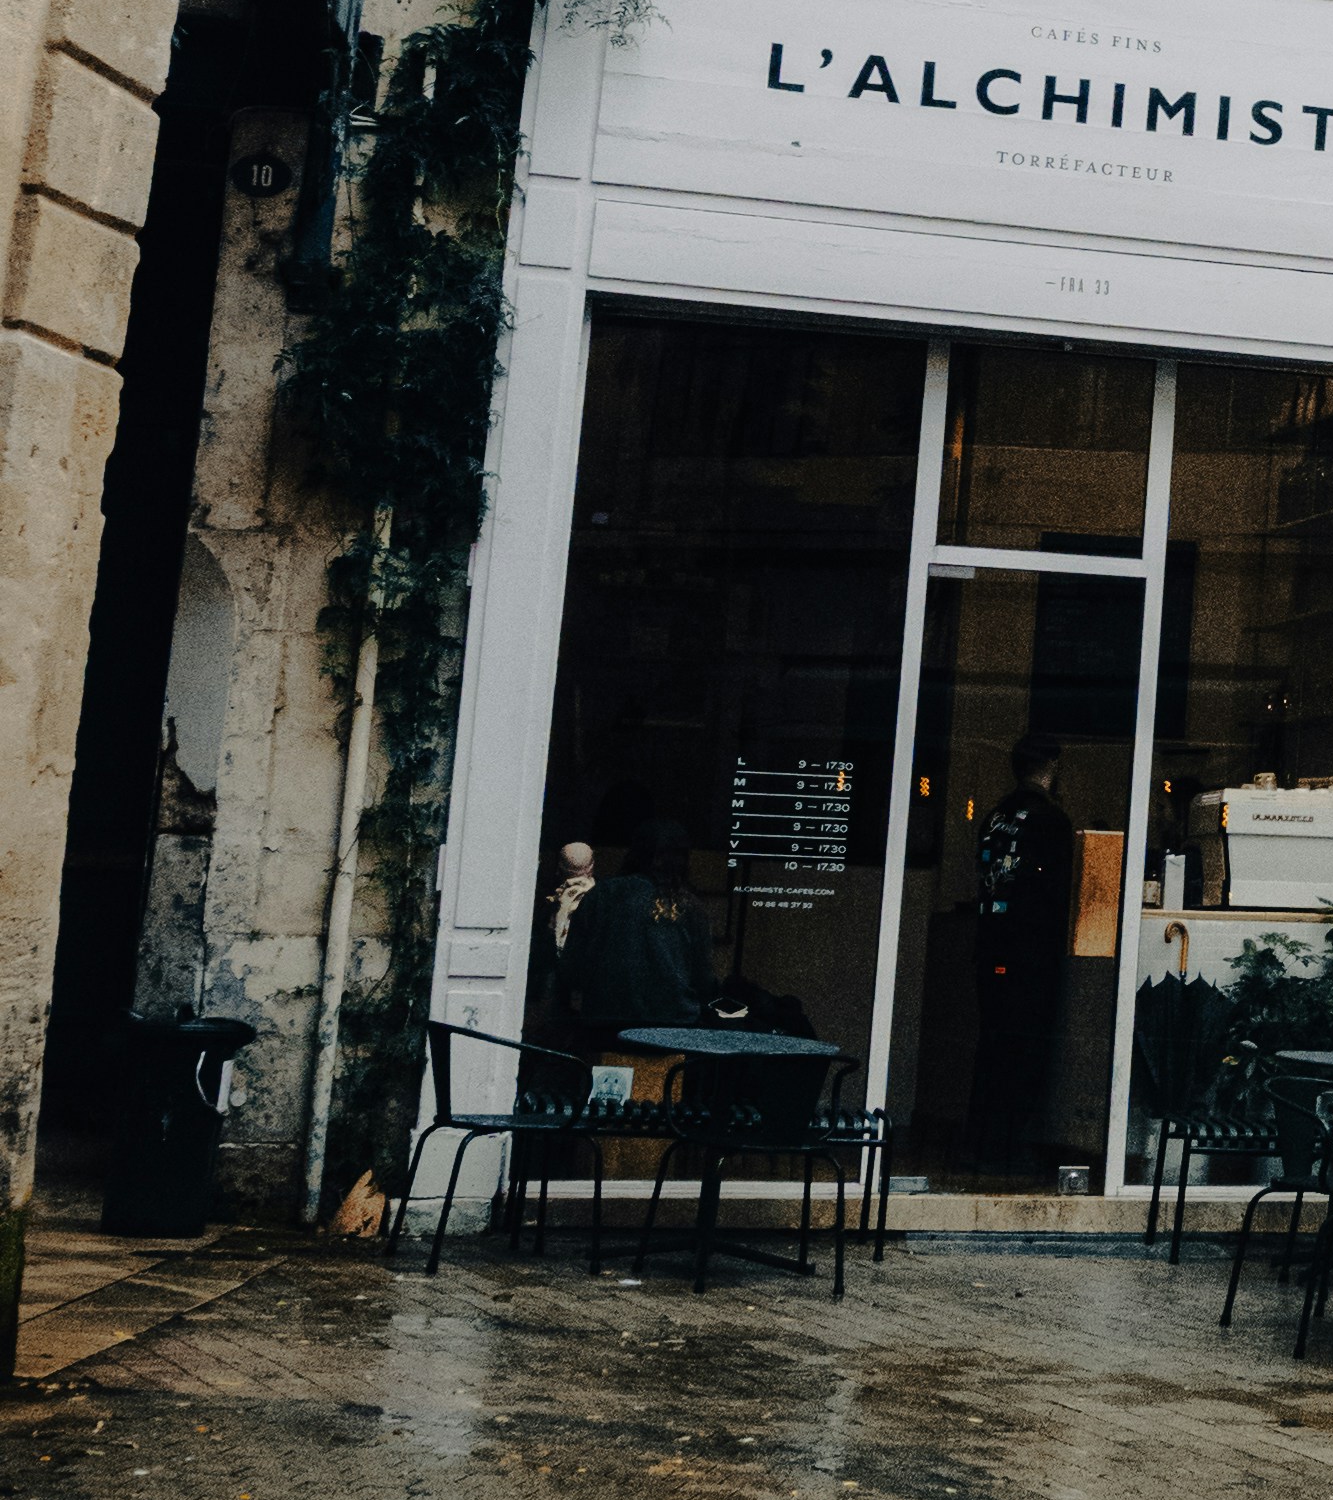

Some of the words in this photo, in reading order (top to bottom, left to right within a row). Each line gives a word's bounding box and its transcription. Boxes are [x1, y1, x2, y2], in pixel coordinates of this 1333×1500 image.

[1031, 26, 1099, 45] CAFÉS
[1112, 35, 1162, 53] FINS
[996, 150, 1176, 185] TORRÉFACTEUR
[252, 164, 273, 187] 10
[1095, 279, 1110, 296] 33
[737, 757, 746, 766] L
[798, 760, 807, 769] 9
[733, 778, 746, 787] M
[796, 780, 805, 790] 9
[731, 799, 744, 808] M
[795, 801, 803, 810] 9
[732, 821, 740, 830] J
[793, 822, 801, 831] 9
[729, 840, 739, 849] V
[791, 843, 799, 852] 9
[728, 859, 737, 868] S
[784, 861, 798, 870] 10
